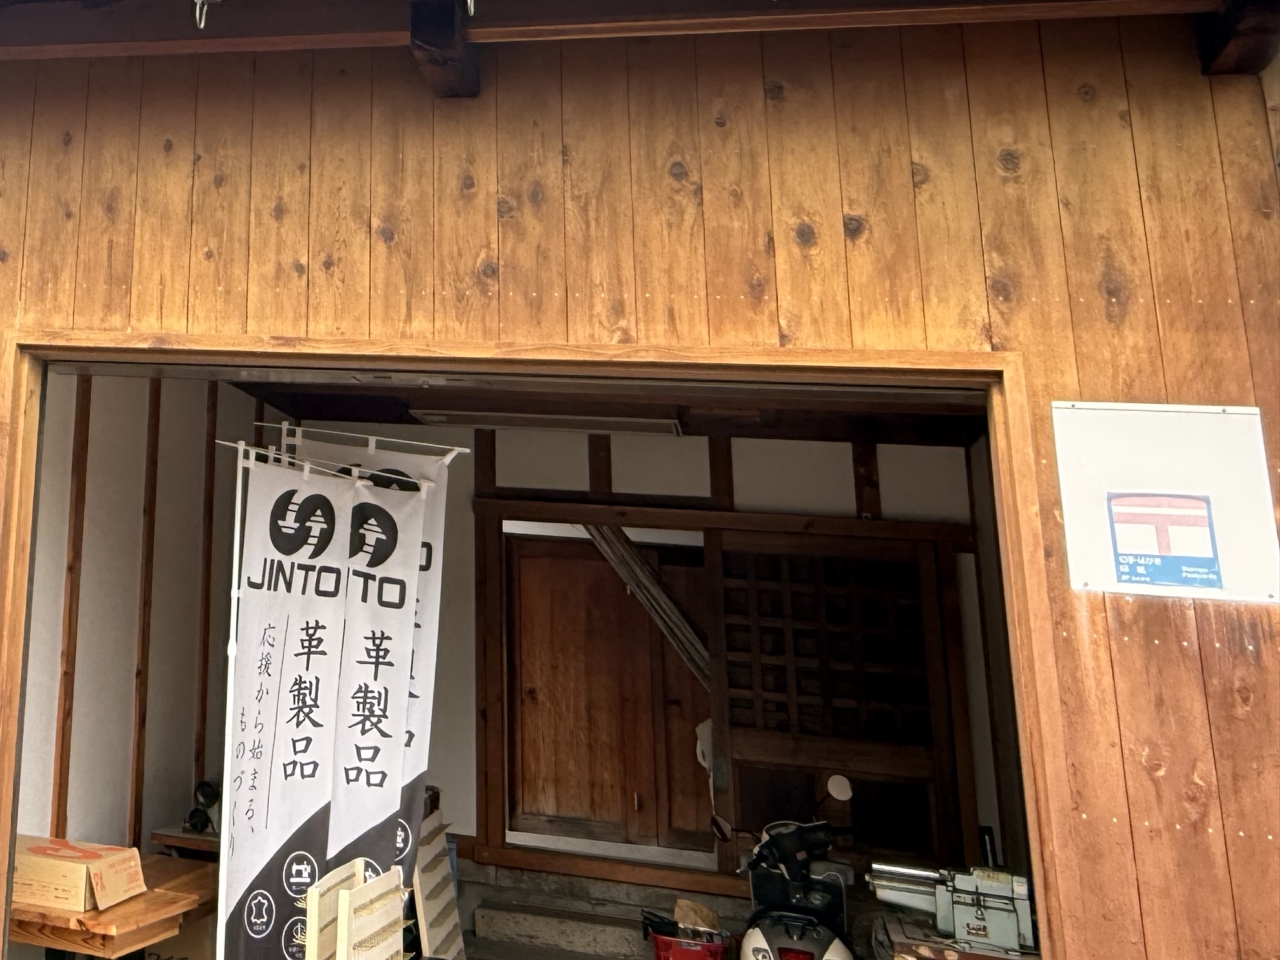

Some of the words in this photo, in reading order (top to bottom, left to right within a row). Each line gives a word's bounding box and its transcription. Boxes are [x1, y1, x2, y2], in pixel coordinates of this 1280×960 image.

[247, 557, 342, 598] JINTO
[282, 619, 328, 781] 革製品
[343, 629, 395, 788] 革製品
